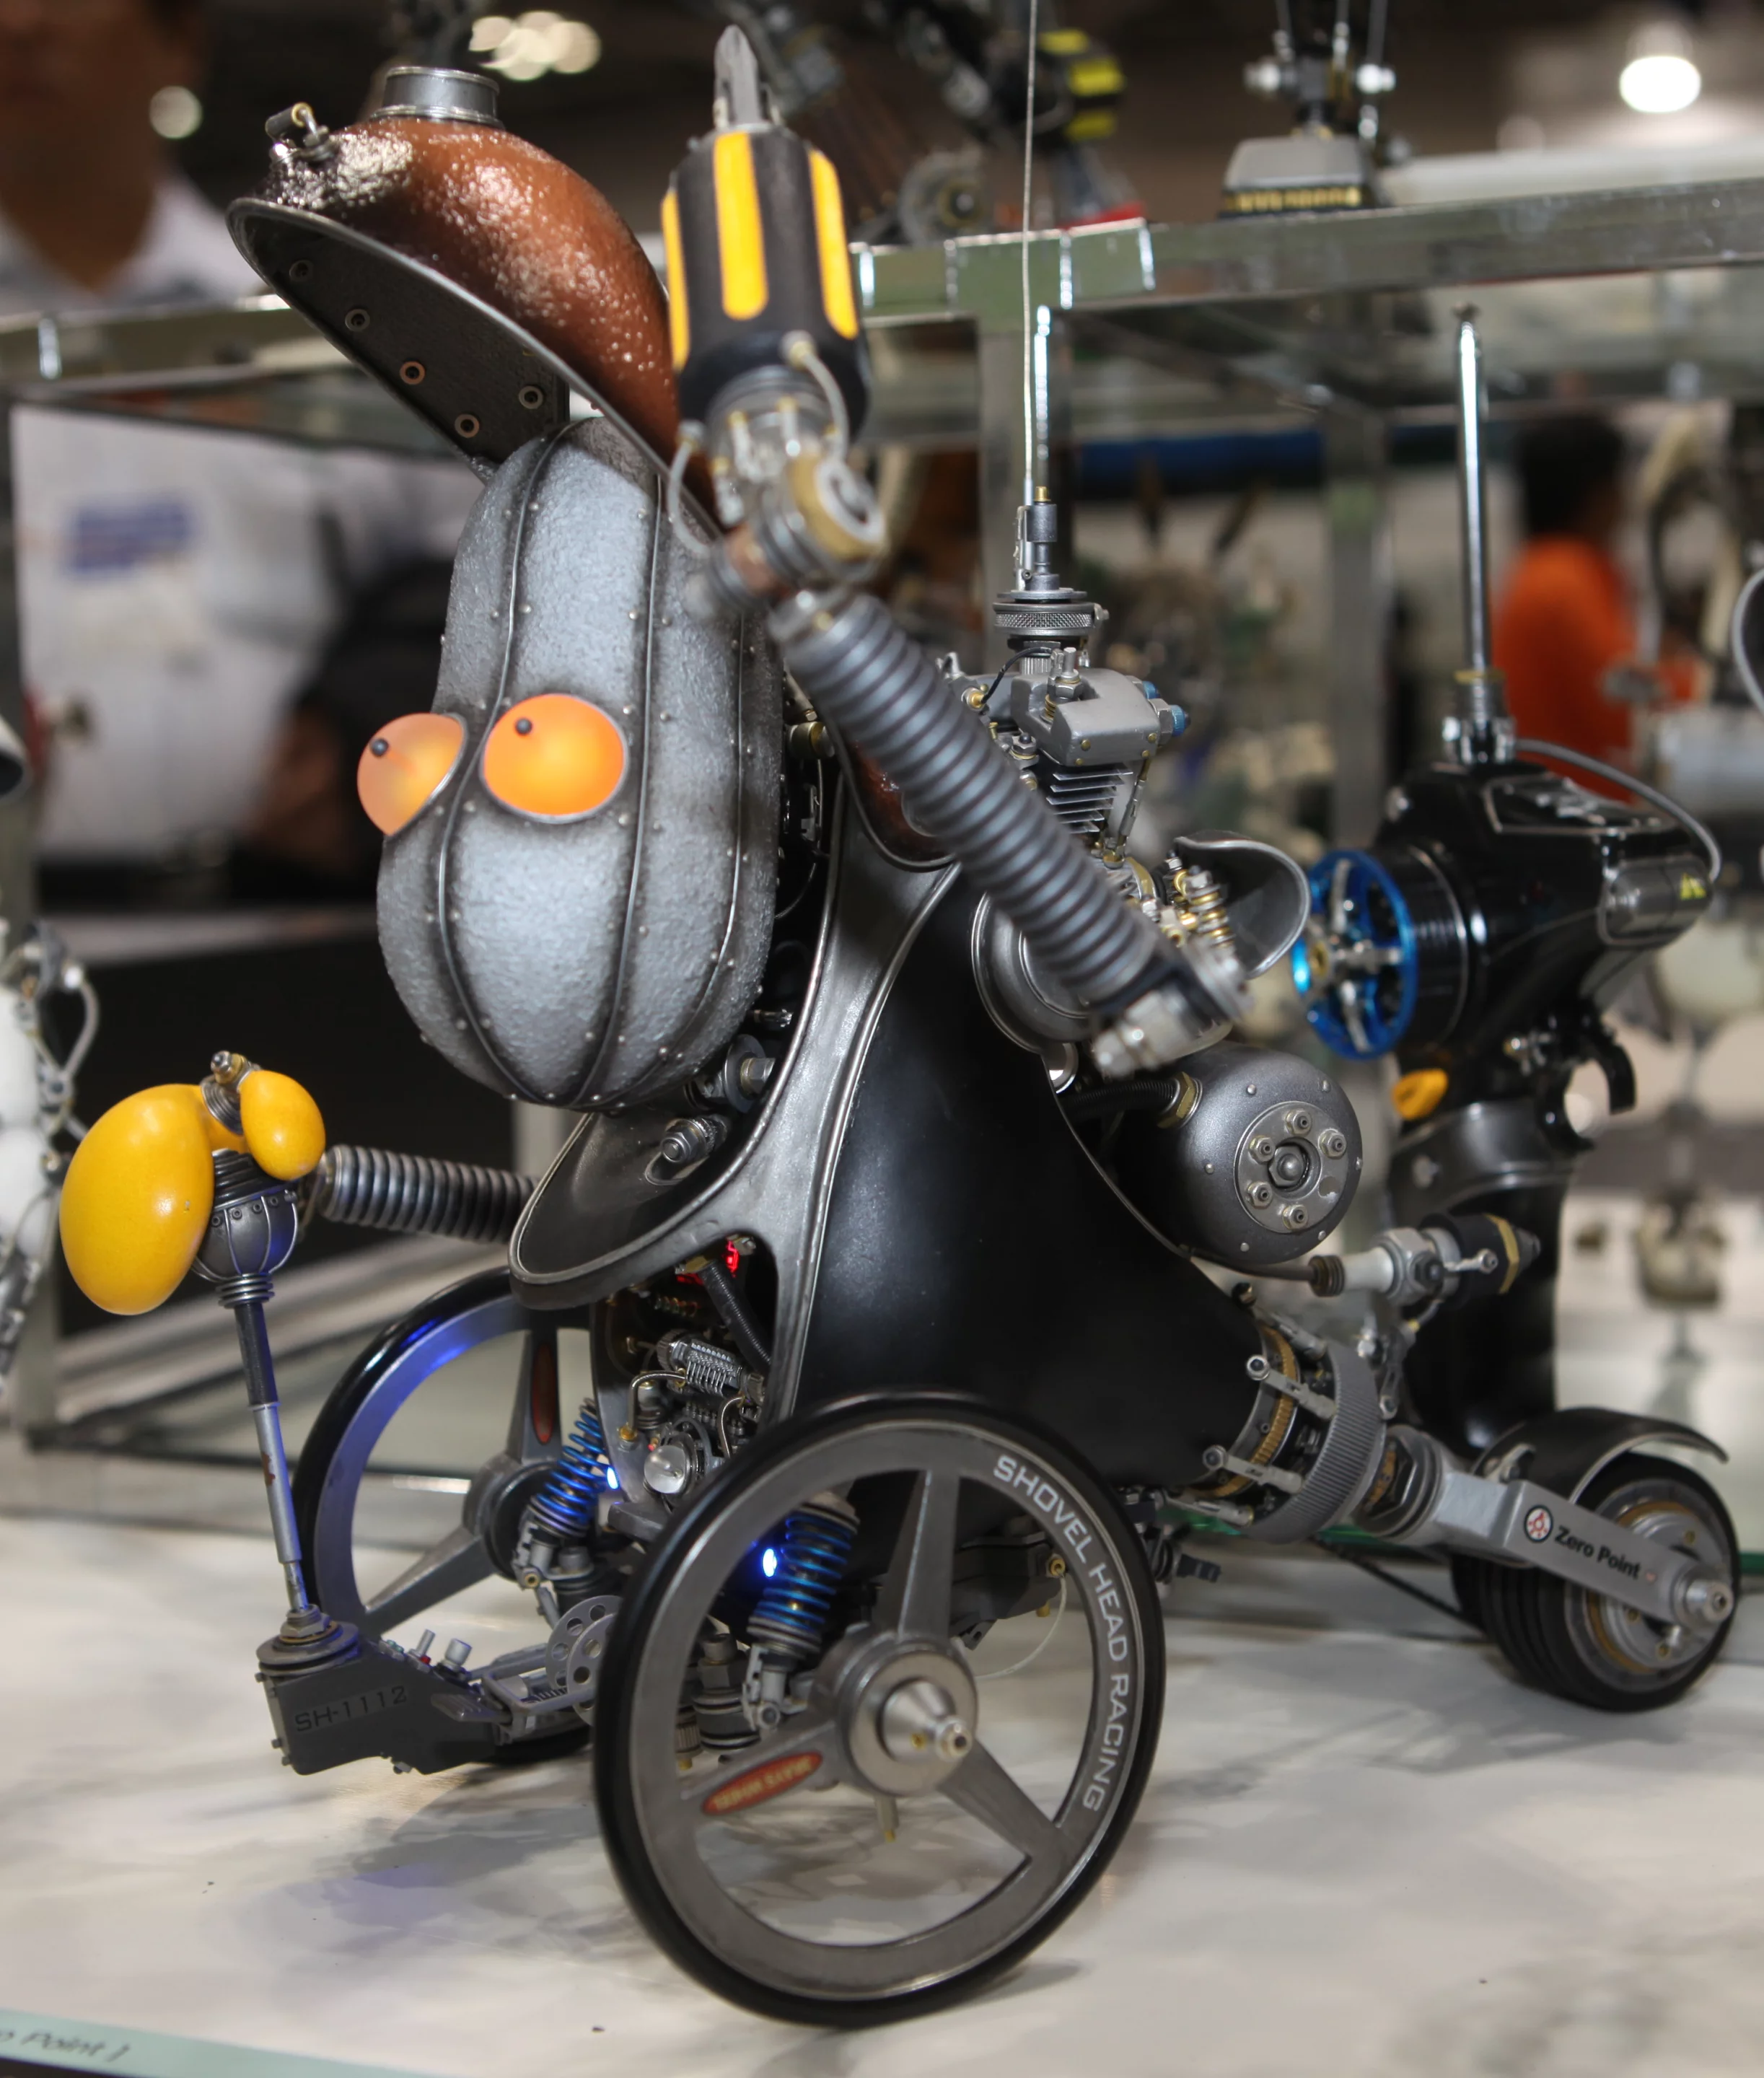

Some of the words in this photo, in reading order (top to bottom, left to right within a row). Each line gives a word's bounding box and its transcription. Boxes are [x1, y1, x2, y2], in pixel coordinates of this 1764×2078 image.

[993, 1455, 1094, 1563] SHOVEL
[1555, 1525, 1594, 1556] Zero
[1597, 1546, 1641, 1580] Point
[1089, 1563, 1129, 1662] HEAD
[295, 1685, 407, 1732] SH-1112
[1083, 1673, 1130, 1812] RACING
